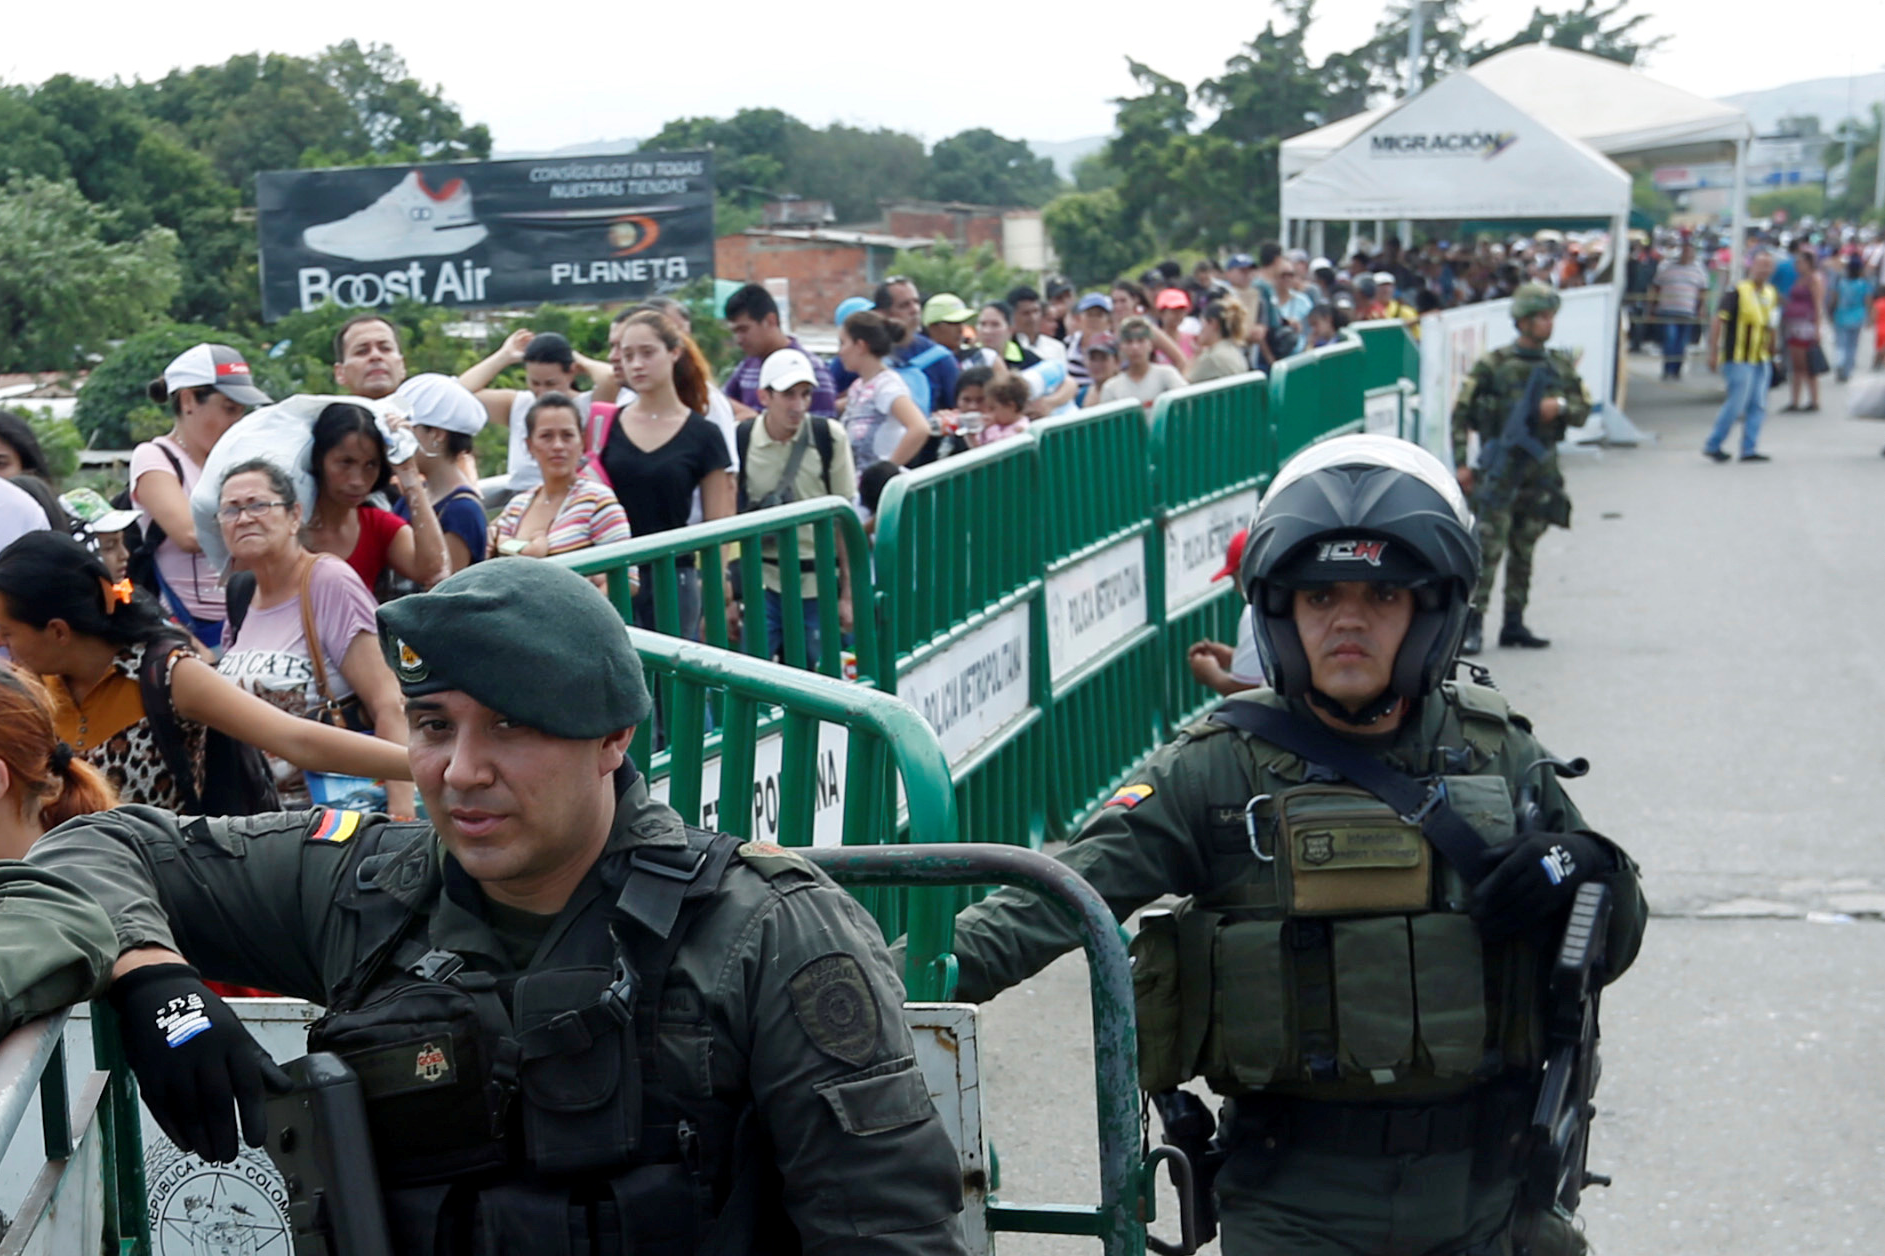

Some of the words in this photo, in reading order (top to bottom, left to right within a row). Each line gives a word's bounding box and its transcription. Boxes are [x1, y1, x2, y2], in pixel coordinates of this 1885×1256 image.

[1370, 131, 1499, 151] MIGRACIÓN
[549, 180, 625, 199] NUESTRAS
[627, 178, 688, 195] TIENDAS
[551, 256, 689, 285] PLANETA
[298, 260, 428, 313] Boost
[433, 259, 492, 303] Air
